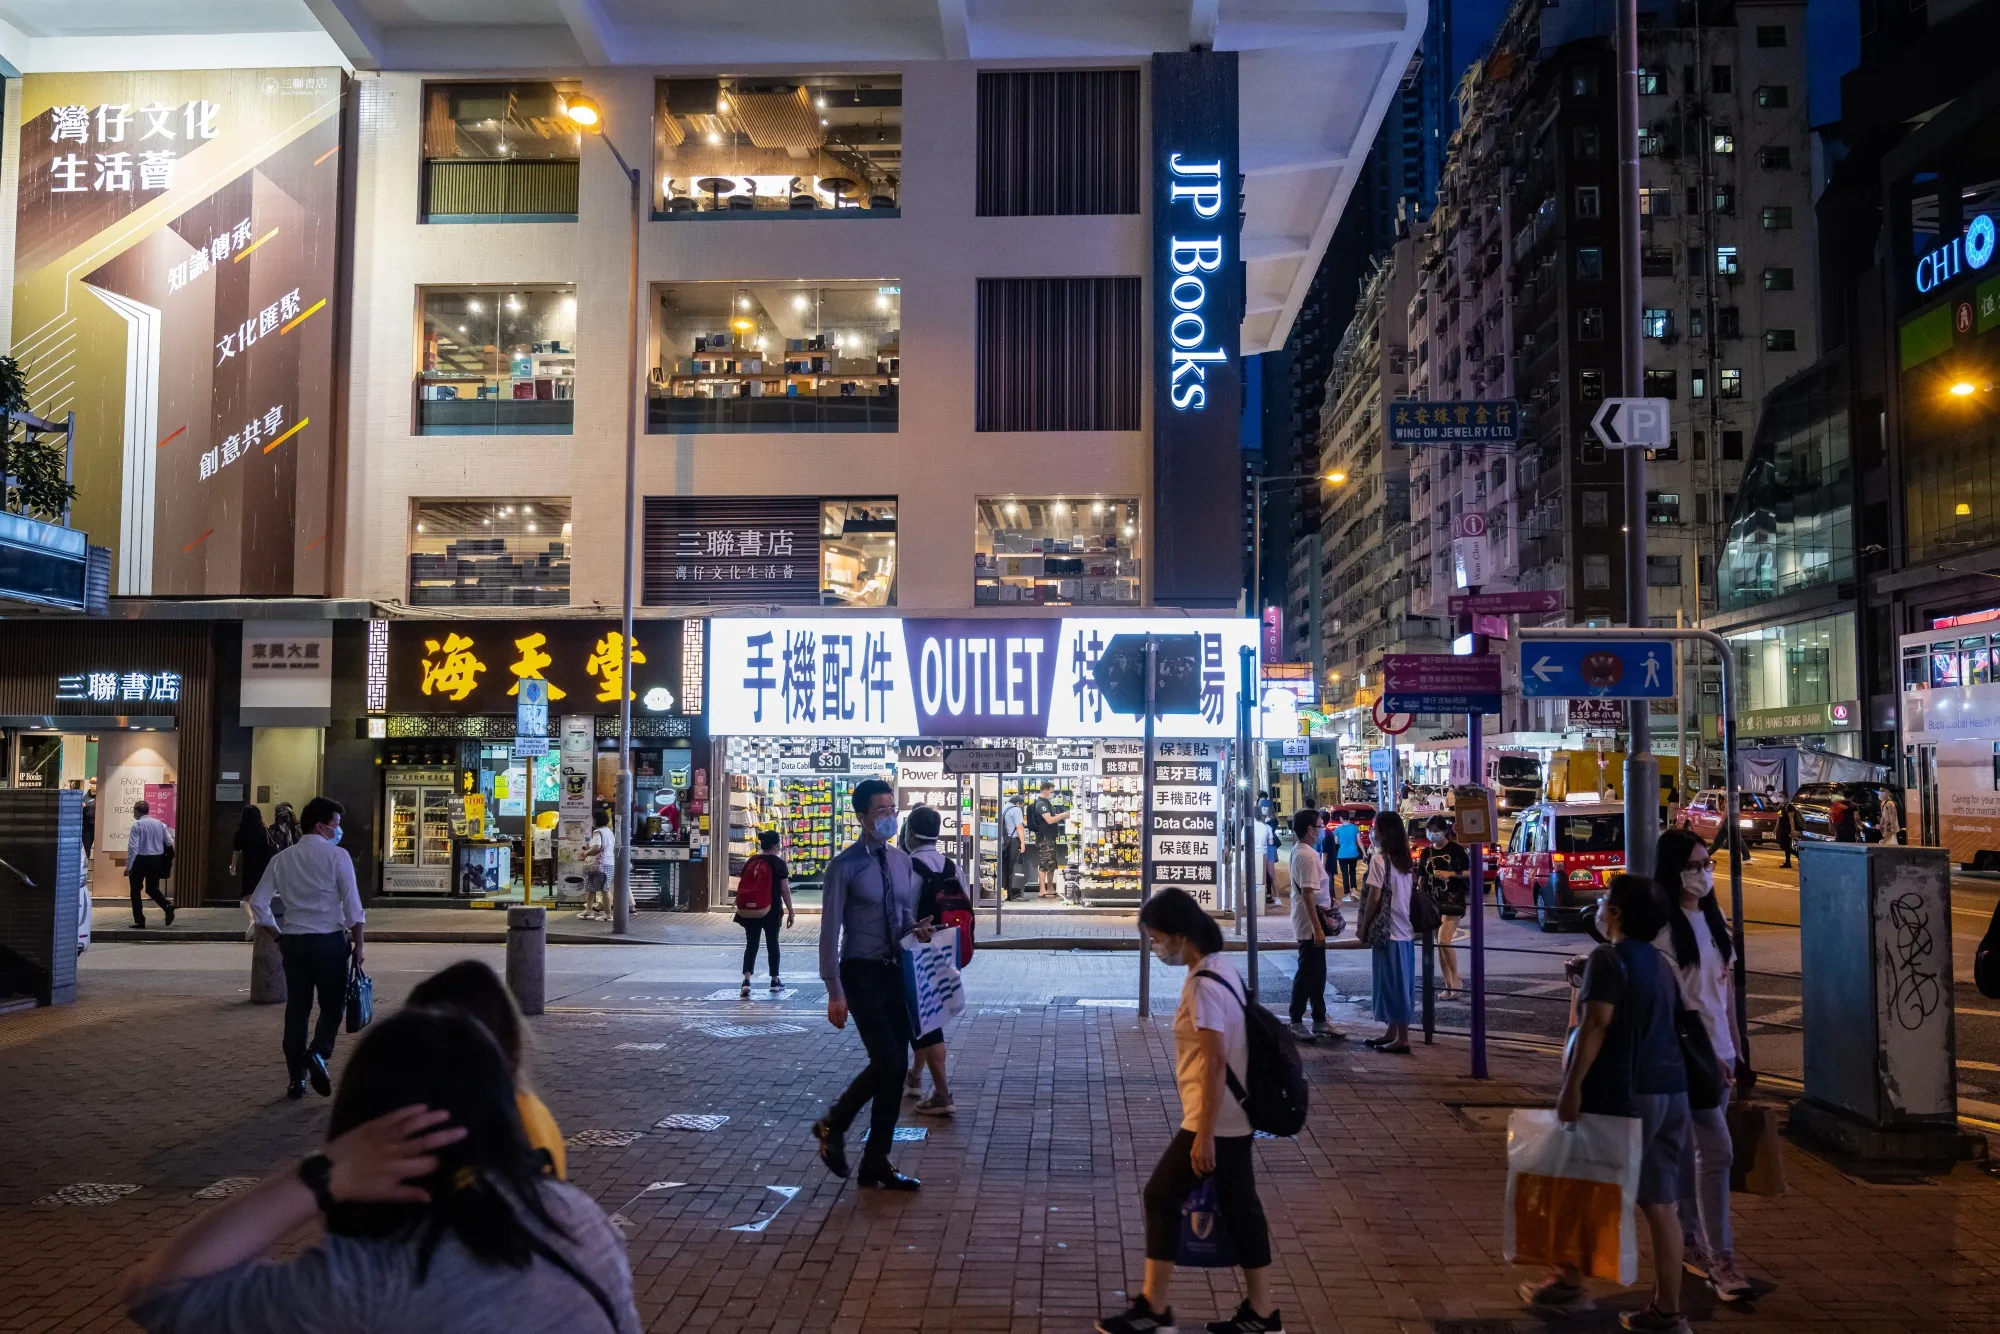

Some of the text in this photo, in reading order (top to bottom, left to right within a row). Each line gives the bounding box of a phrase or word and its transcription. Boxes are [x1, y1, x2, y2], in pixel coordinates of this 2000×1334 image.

[50, 100, 221, 144] 灣仔文化
[50, 149, 177, 193] 生活薈
[167, 217, 252, 297] 知識傳承
[1170, 153, 1227, 410] JP Books
[216, 287, 301, 368] 文化匯聚
[1396, 427, 1512, 438] WING ON JEWELRY LTD.
[199, 404, 284, 482] 創意共享
[675, 529, 794, 557] 三聯書店
[1472, 541, 1480, 560] Chai
[675, 564, 794, 580] 灣仔文化生活薈
[421, 632, 647, 702] 海天堂
[743, 630, 894, 724] 手機配件
[920, 637, 1044, 717] OUTLET
[1072, 629, 1226, 726] 特場
[56, 673, 181, 701] 三聯書店
[1765, 717, 1782, 729] HANG
[1784, 715, 1801, 726] SENG
[1802, 713, 1821, 725] BANK
[1928, 720, 1945, 730] Bupa
[1969, 718, 1992, 728] Health
[995, 750, 1014, 758] Road
[1159, 742, 1209, 757] 保護貼
[1288, 745, 1304, 754] 全日
[781, 762, 798, 771] Data
[798, 761, 811, 770] Cabl
[818, 755, 842, 767] $30
[851, 762, 872, 772] Tempered
[873, 762, 885, 770] Glass
[1061, 762, 1090, 772] 批發價
[1106, 761, 1139, 773] 批發價
[120, 777, 148, 785] ENJOY
[901, 768, 938, 781] Power
[1155, 765, 1213, 781] 藍牙耳機
[126, 787, 142, 795] LIFE
[1156, 790, 1212, 806] 手機配件
[1952, 794, 1995, 806] Caring for your
[1965, 807, 1976, 815] our
[1976, 807, 1997, 816] mental
[1153, 816, 1214, 829] Data Cable
[1159, 840, 1209, 856] 保護貼
[1155, 865, 1213, 880] 藍牙耳機
